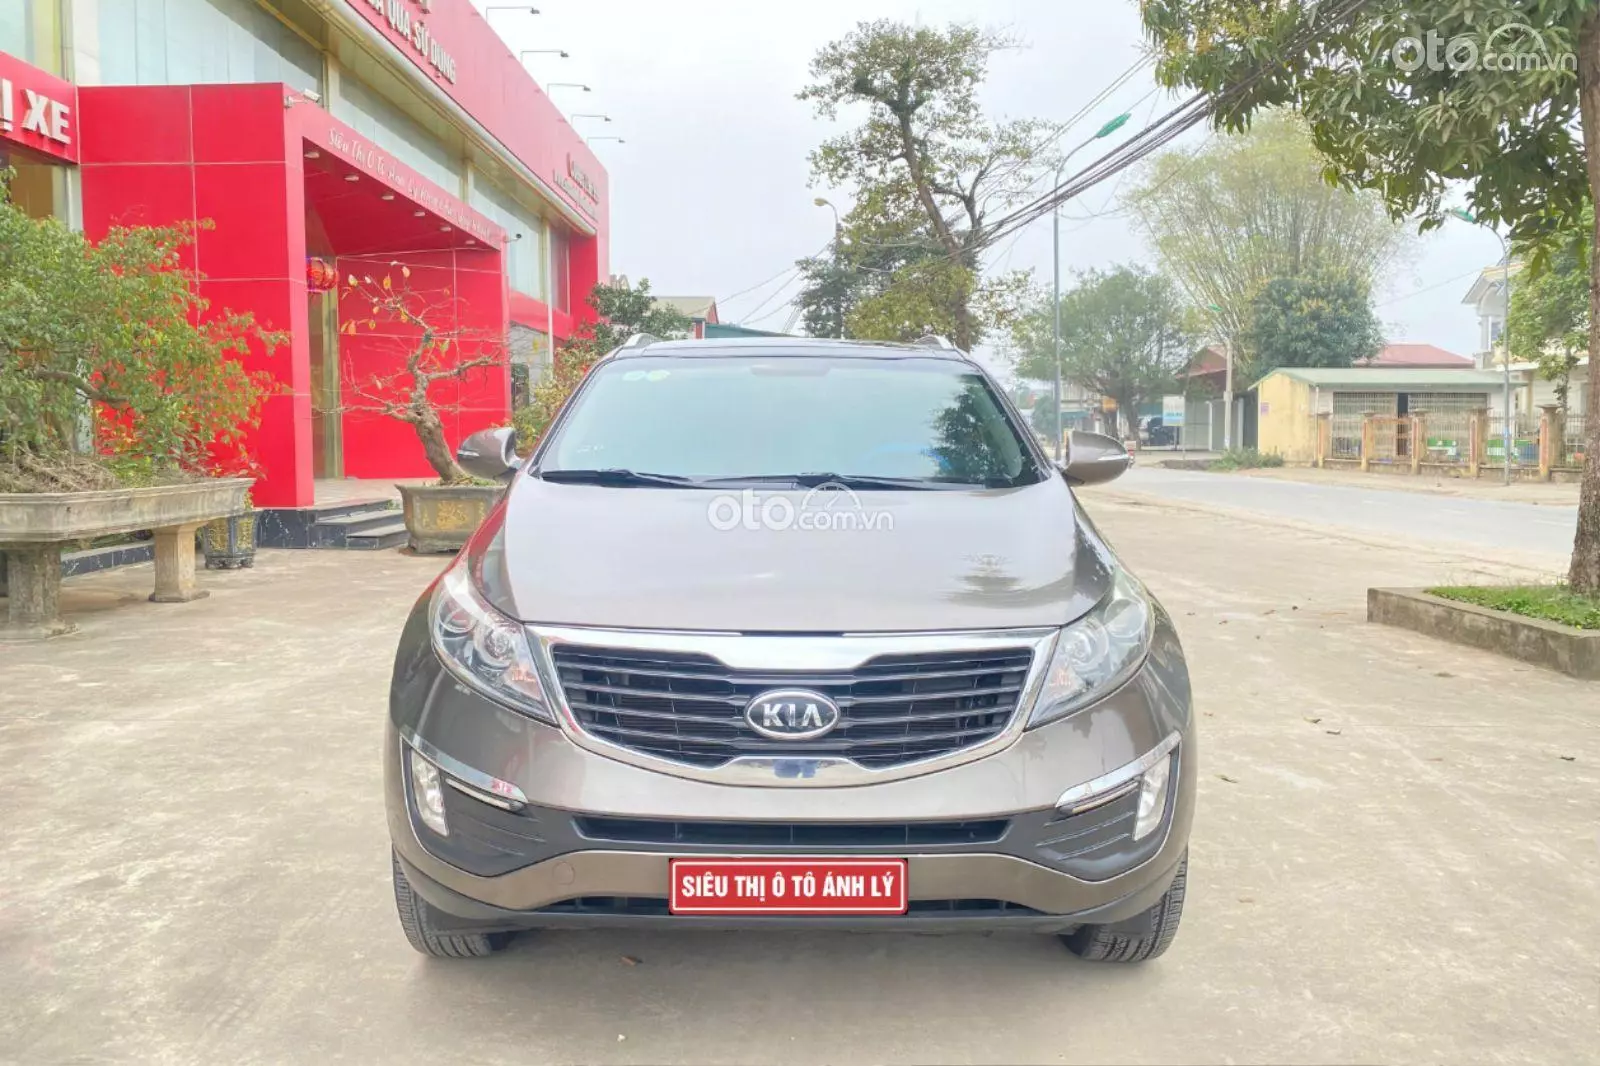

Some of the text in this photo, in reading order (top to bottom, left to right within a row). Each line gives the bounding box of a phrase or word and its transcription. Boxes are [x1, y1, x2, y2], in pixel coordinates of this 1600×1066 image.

[21, 88, 71, 145] XE
[762, 703, 823, 727] KIA
[681, 871, 894, 902] SIÊU THỊ Ô TÔ ÁNH LÝ
